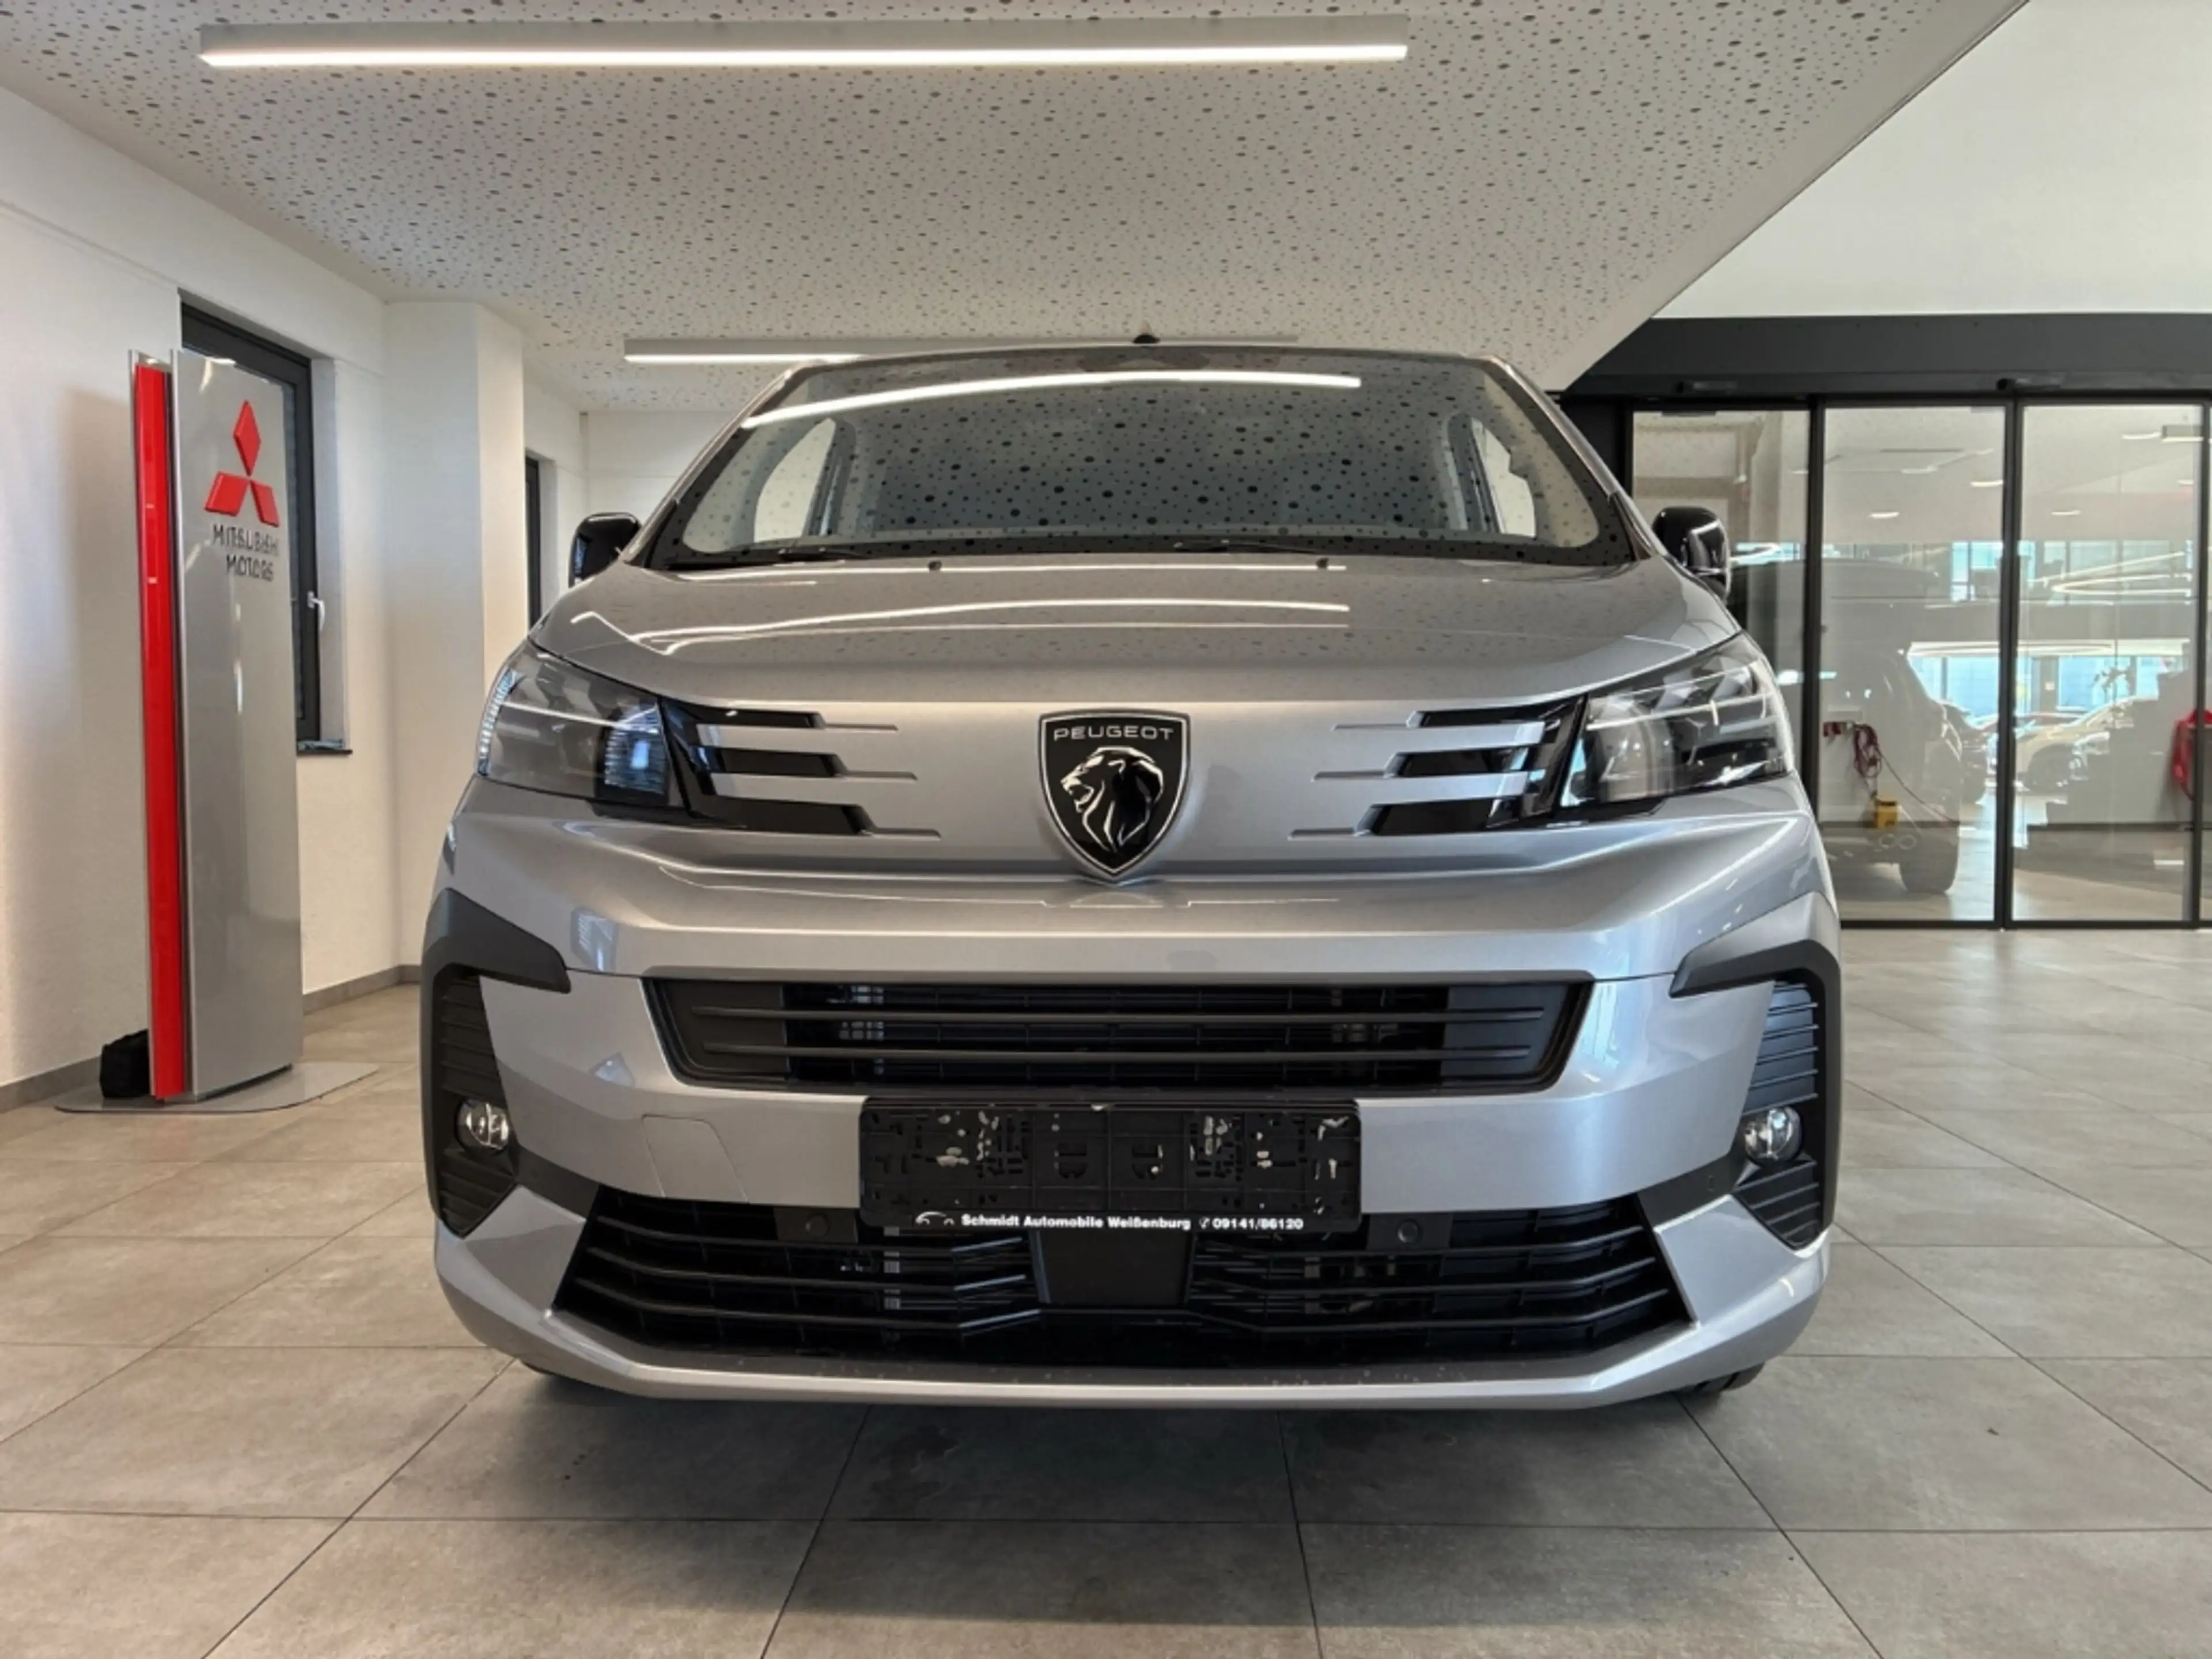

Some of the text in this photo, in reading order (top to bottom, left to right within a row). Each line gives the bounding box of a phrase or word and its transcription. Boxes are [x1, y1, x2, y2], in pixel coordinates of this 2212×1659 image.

[1054, 725, 1174, 741] PEUGEOT
[961, 1213, 1019, 1226] Schmidt
[1023, 1215, 1104, 1228] Automobile
[1107, 1216, 1191, 1231] Weißenburg
